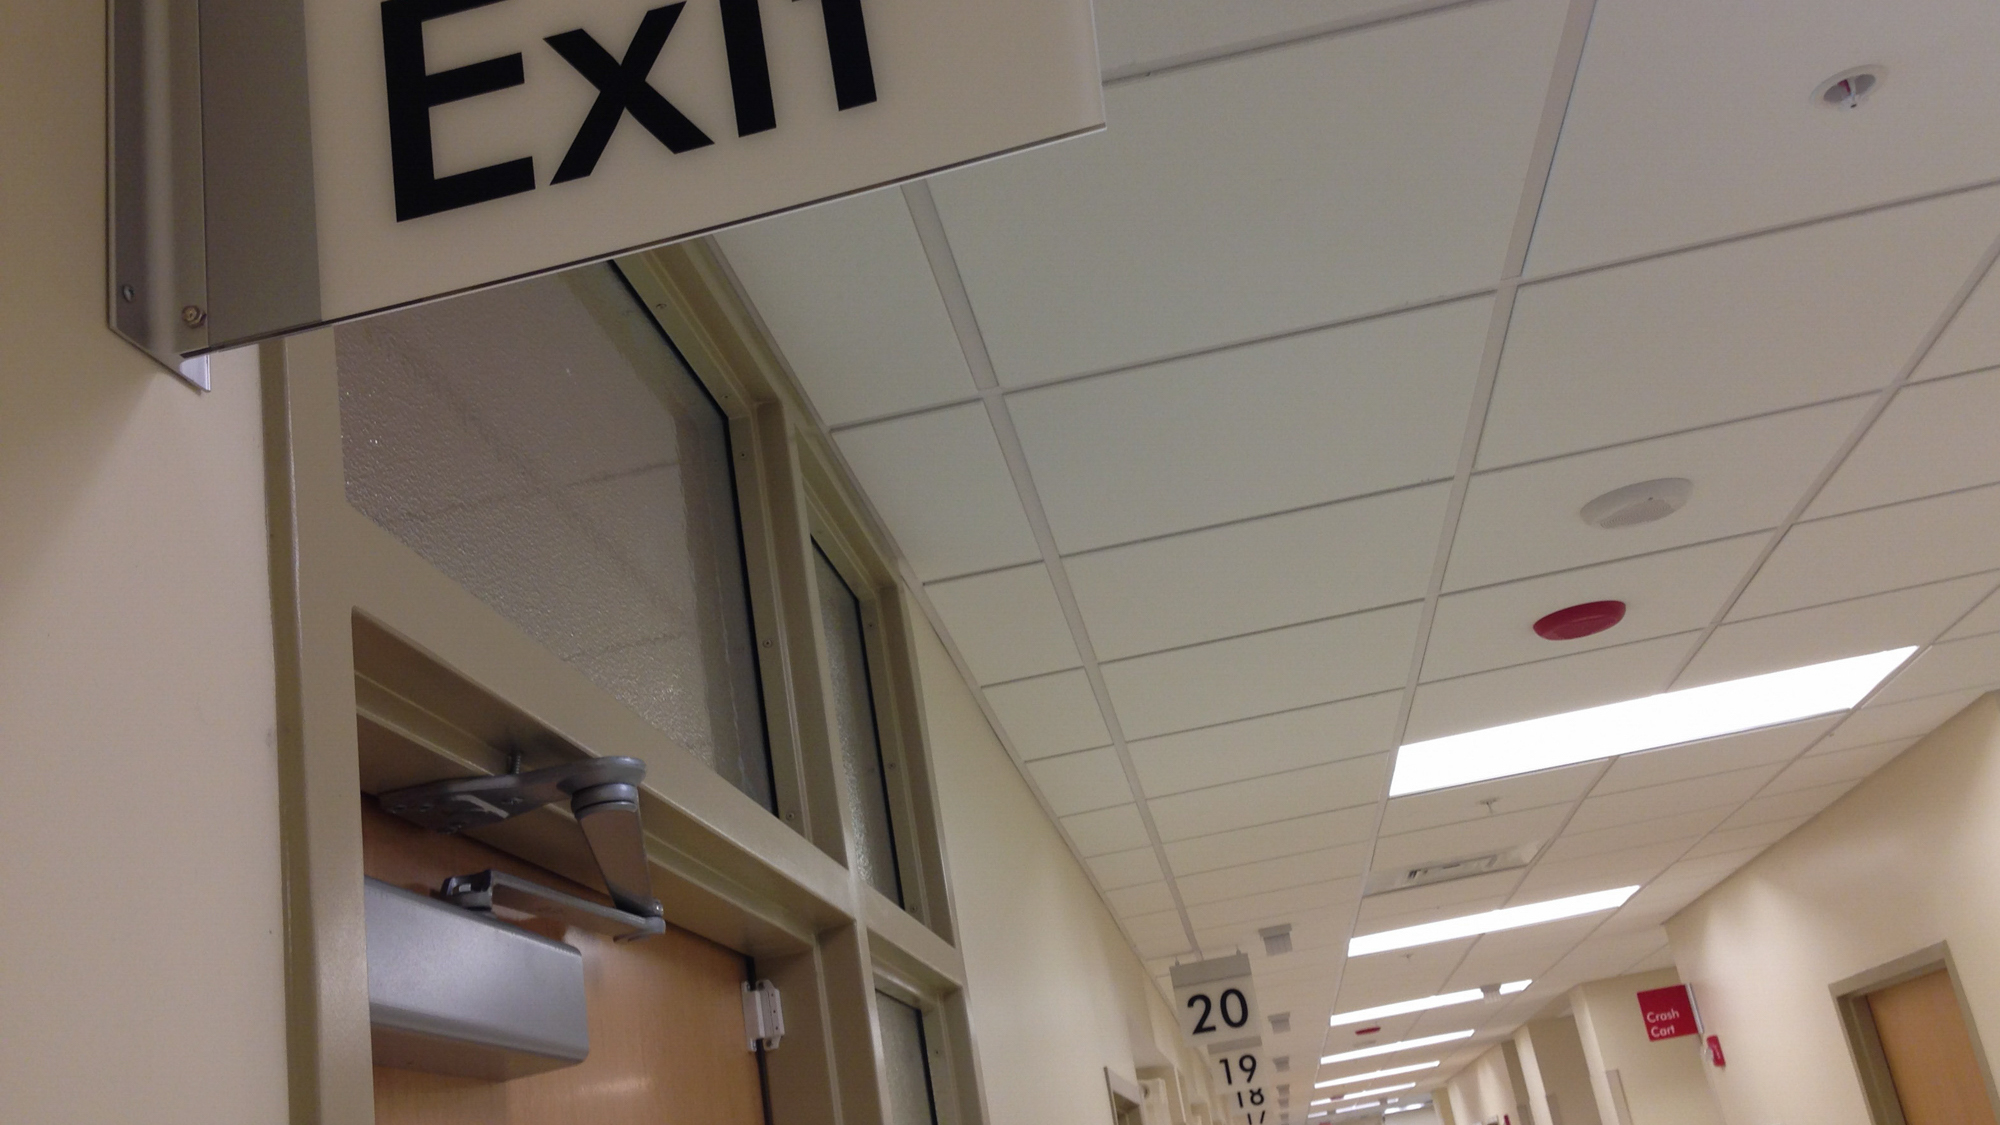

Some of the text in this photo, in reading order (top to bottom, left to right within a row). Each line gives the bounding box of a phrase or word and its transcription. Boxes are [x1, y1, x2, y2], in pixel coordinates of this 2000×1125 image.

[1187, 988, 1249, 1035] 20
[1646, 1008, 1680, 1023] Crash
[1650, 1025, 1675, 1038] Cart
[1219, 1054, 1257, 1086] 19
